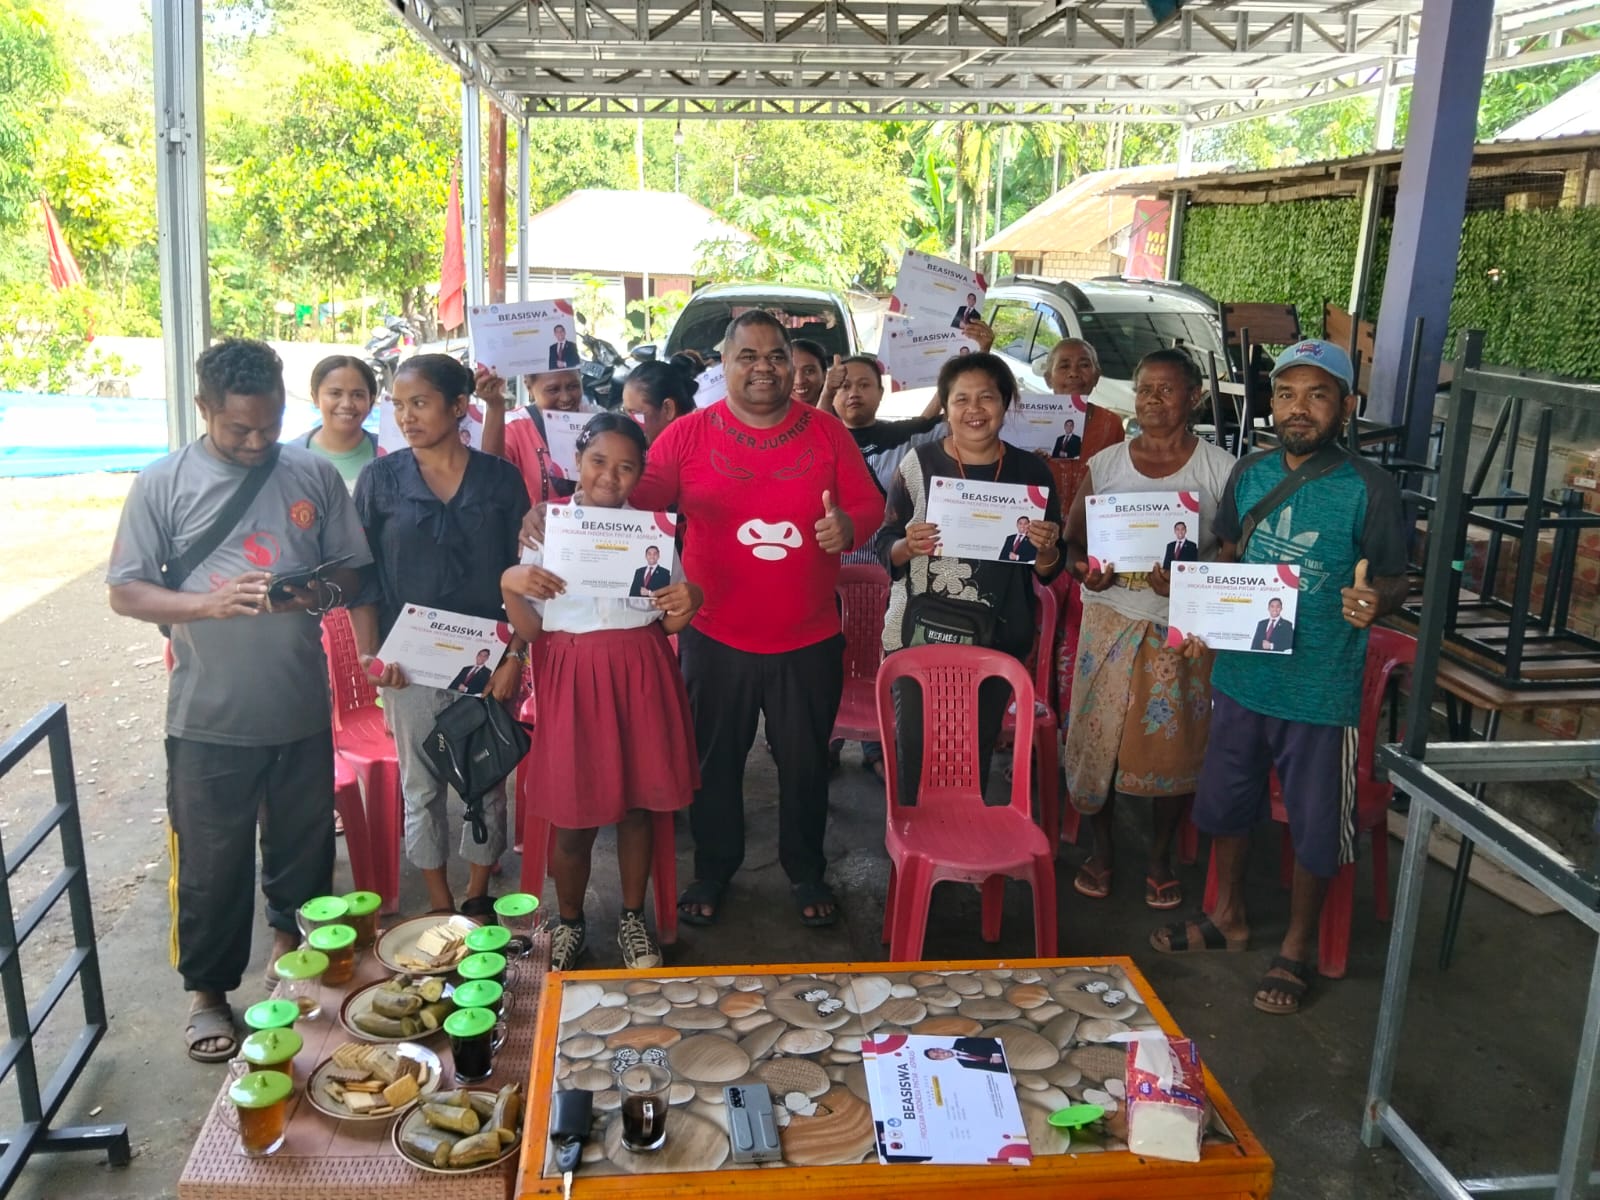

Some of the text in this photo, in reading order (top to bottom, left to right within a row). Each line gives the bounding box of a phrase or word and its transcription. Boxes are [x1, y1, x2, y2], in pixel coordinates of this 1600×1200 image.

[927, 263, 968, 282] BEASISWA
[498, 310, 548, 322] BEASISWA
[912, 331, 957, 343] BEASISWA
[1019, 403, 1064, 411] BEASISWA
[961, 492, 1017, 504] BEASISWA
[1115, 503, 1170, 513] BEASISWA
[581, 520, 643, 533] BEASISWA
[1206, 575, 1267, 586] BEASISWA
[430, 621, 483, 638] BEASISWA
[897, 1062, 916, 1120] BEASISWA
